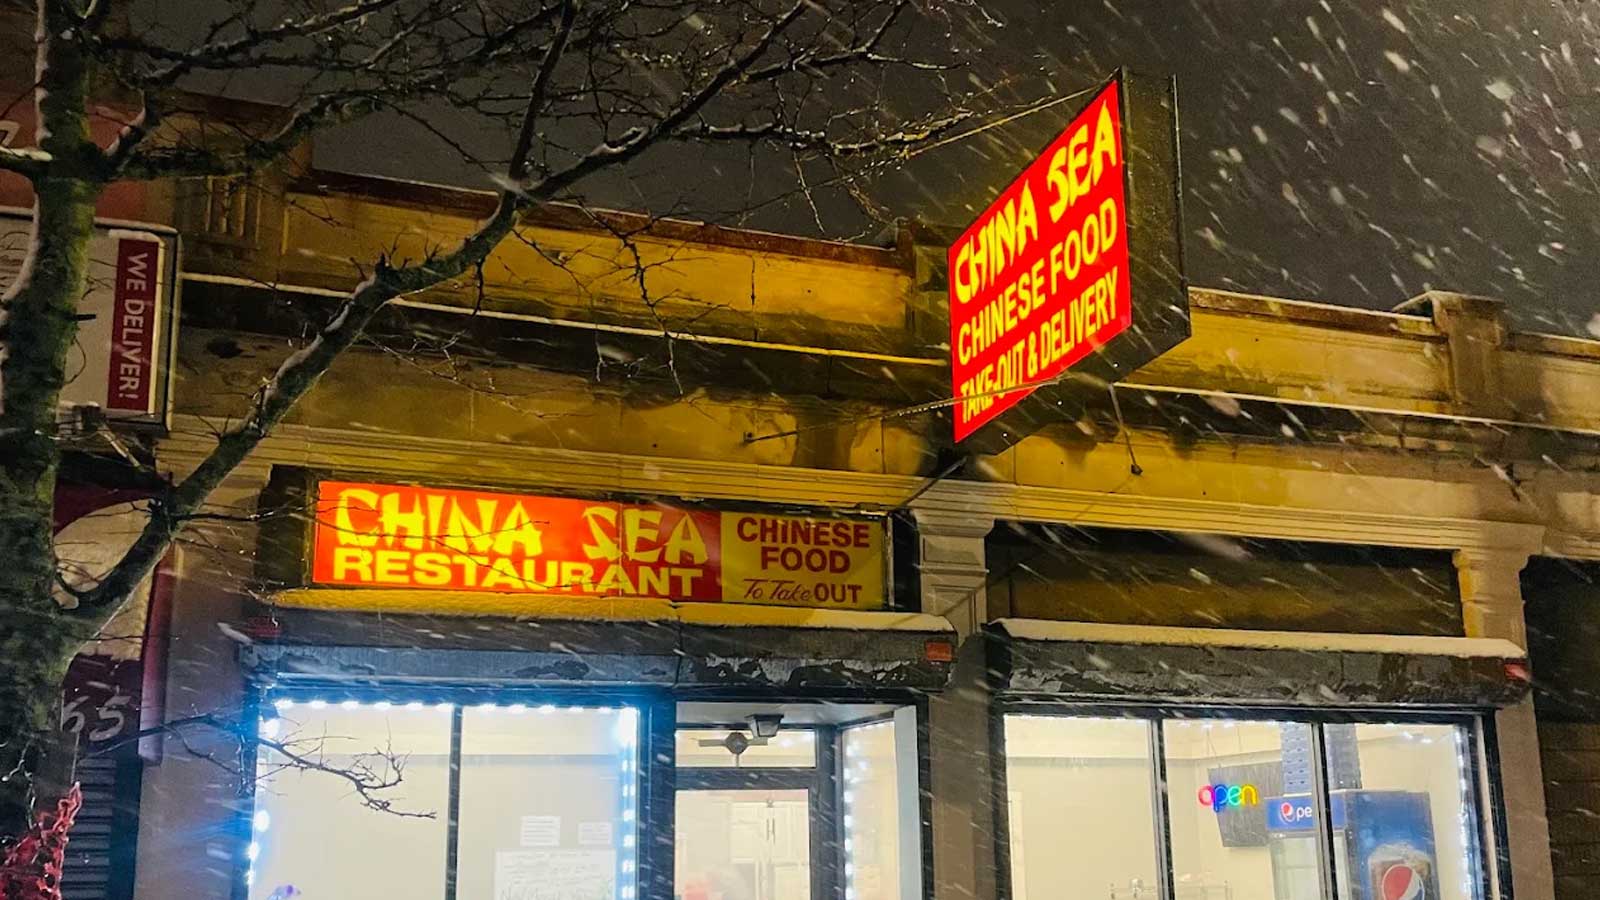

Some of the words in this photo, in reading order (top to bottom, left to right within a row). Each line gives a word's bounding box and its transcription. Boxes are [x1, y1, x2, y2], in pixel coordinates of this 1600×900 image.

[954, 179, 1038, 304] CHINA
[1046, 99, 1117, 224] SEA
[127, 252, 149, 292] WE
[958, 258, 1046, 366] CHINESE
[1050, 197, 1118, 295] FOOD
[118, 299, 146, 400] DELIVER!
[960, 339, 1024, 424] TAKE-OUT
[1027, 330, 1038, 378] &
[1040, 265, 1118, 370] DELIVERY
[335, 488, 543, 558] CHINA
[582, 506, 708, 566] SEA
[737, 517, 869, 548] CHINESE
[333, 547, 703, 597] RESTAURANT
[761, 546, 850, 574] FOOD
[743, 578, 769, 600] To
[769, 579, 813, 602] Take
[813, 583, 862, 604] OUT
[1197, 784, 1258, 813] open
